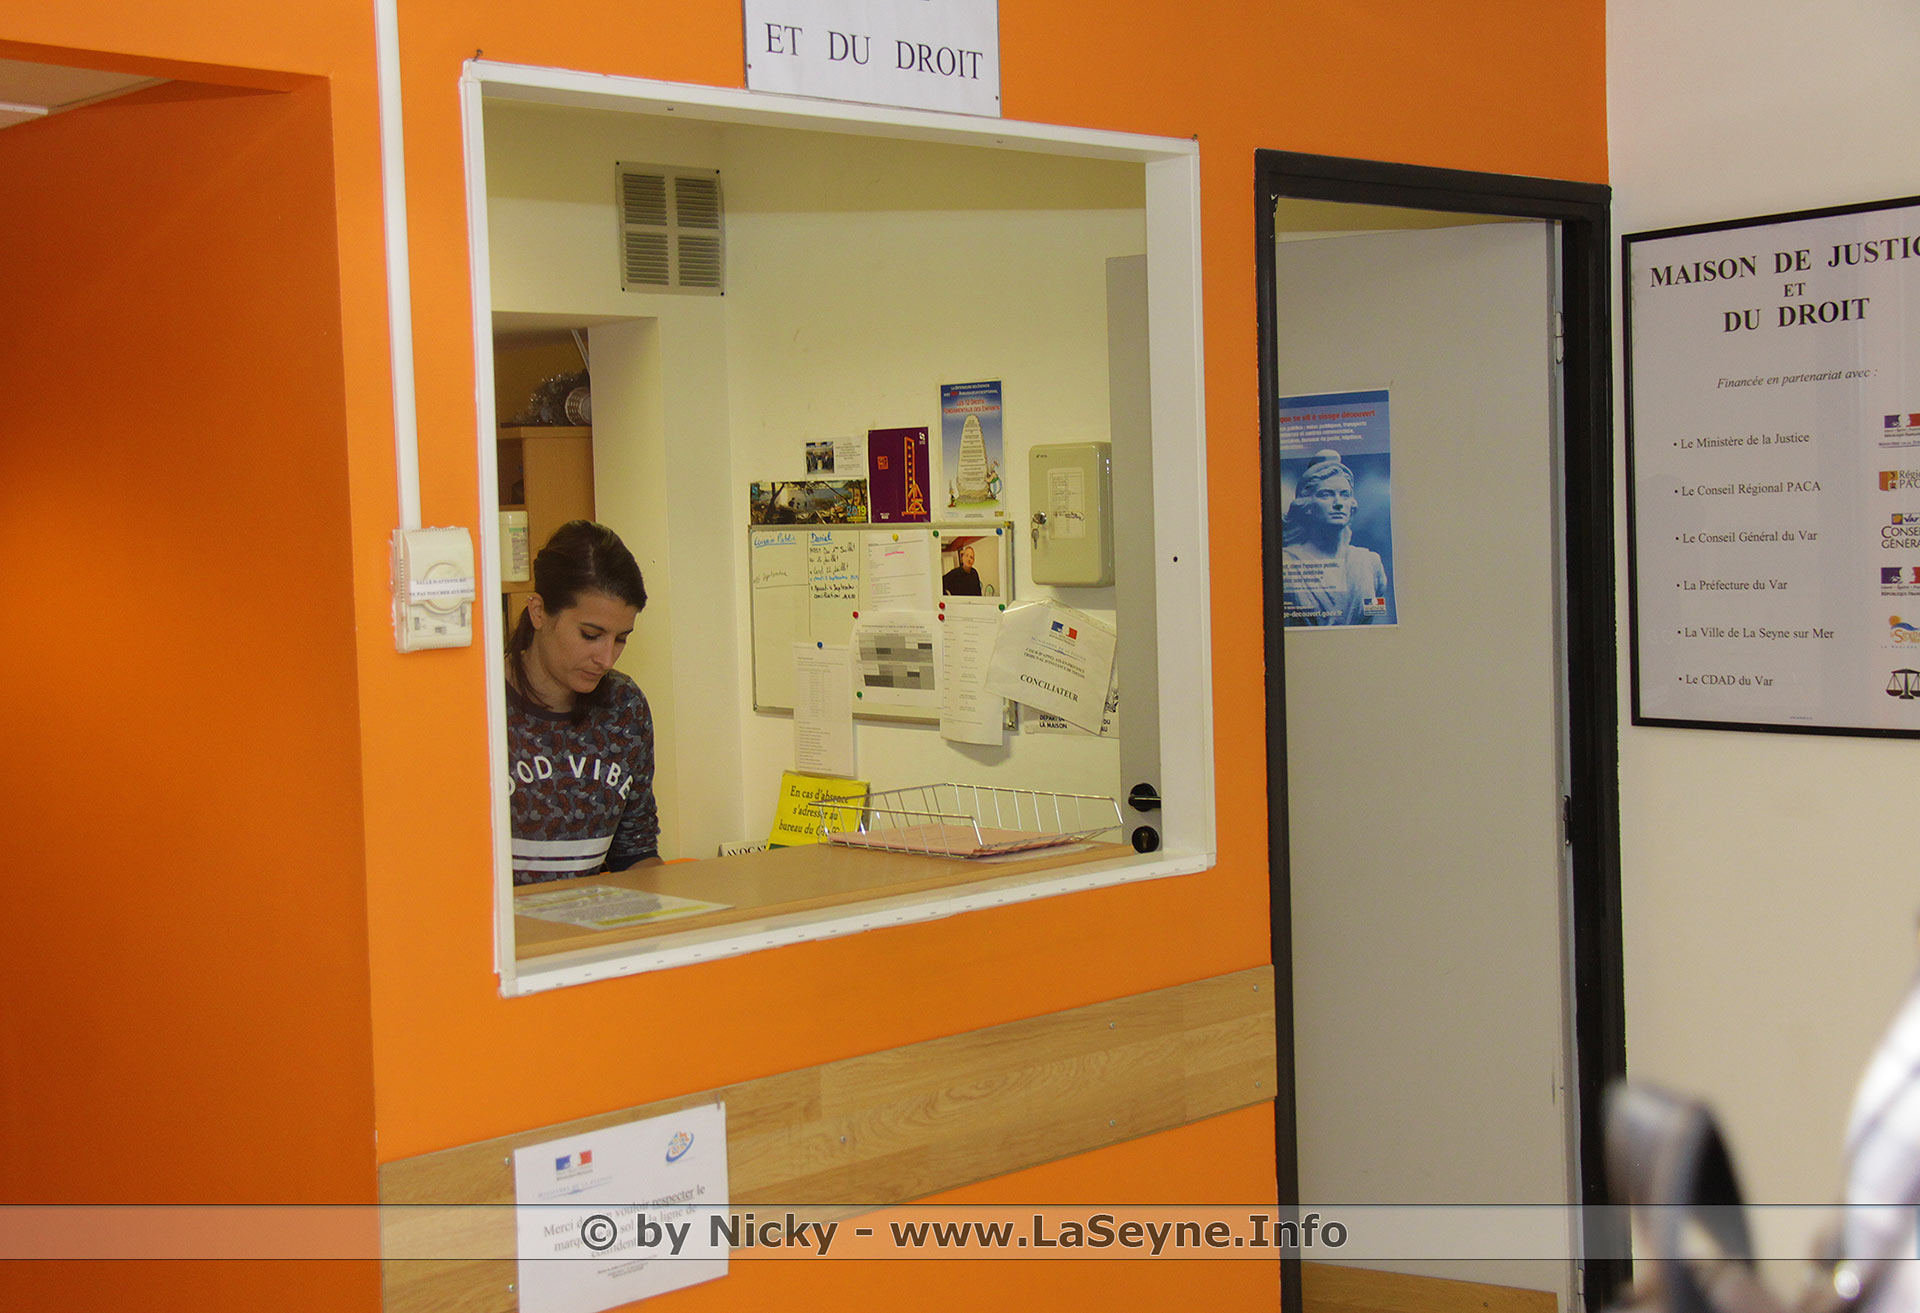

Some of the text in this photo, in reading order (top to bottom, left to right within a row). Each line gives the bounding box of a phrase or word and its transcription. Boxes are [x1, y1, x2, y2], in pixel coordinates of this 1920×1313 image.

[765, 22, 983, 80] ET DU DROIT
[1650, 255, 1757, 288] MAISON
[1774, 249, 1812, 274] DE
[1783, 282, 1806, 297] ET
[1723, 298, 1870, 332] DU DROIT
[1717, 374, 1763, 388] Financée
[1766, 377, 1779, 385] en
[1781, 370, 1842, 387] partenariat
[1845, 370, 1871, 379] avec
[1680, 432, 1810, 450] Le Ministère de la Justice
[1682, 481, 1821, 497] Le Conseil Régional PACA
[1682, 530, 1818, 543] Le Conseil Général du Var
[1683, 580, 1788, 591] La Préfecture du Var
[1685, 627, 1834, 641] La Ville de La Seyne sur Mer
[1020, 673, 1079, 702] CONCILIATEUR
[1686, 675, 1774, 686] Le CDAD du Var
[790, 786, 800, 798] En
[802, 790, 813, 799] cas
[778, 819, 802, 833] bureau
[804, 823, 814, 835] du
[544, 1220, 574, 1238] Merci
[652, 1189, 694, 1209] respecter
[697, 1184, 706, 1195] le
[660, 1208, 682, 1224] ligne
